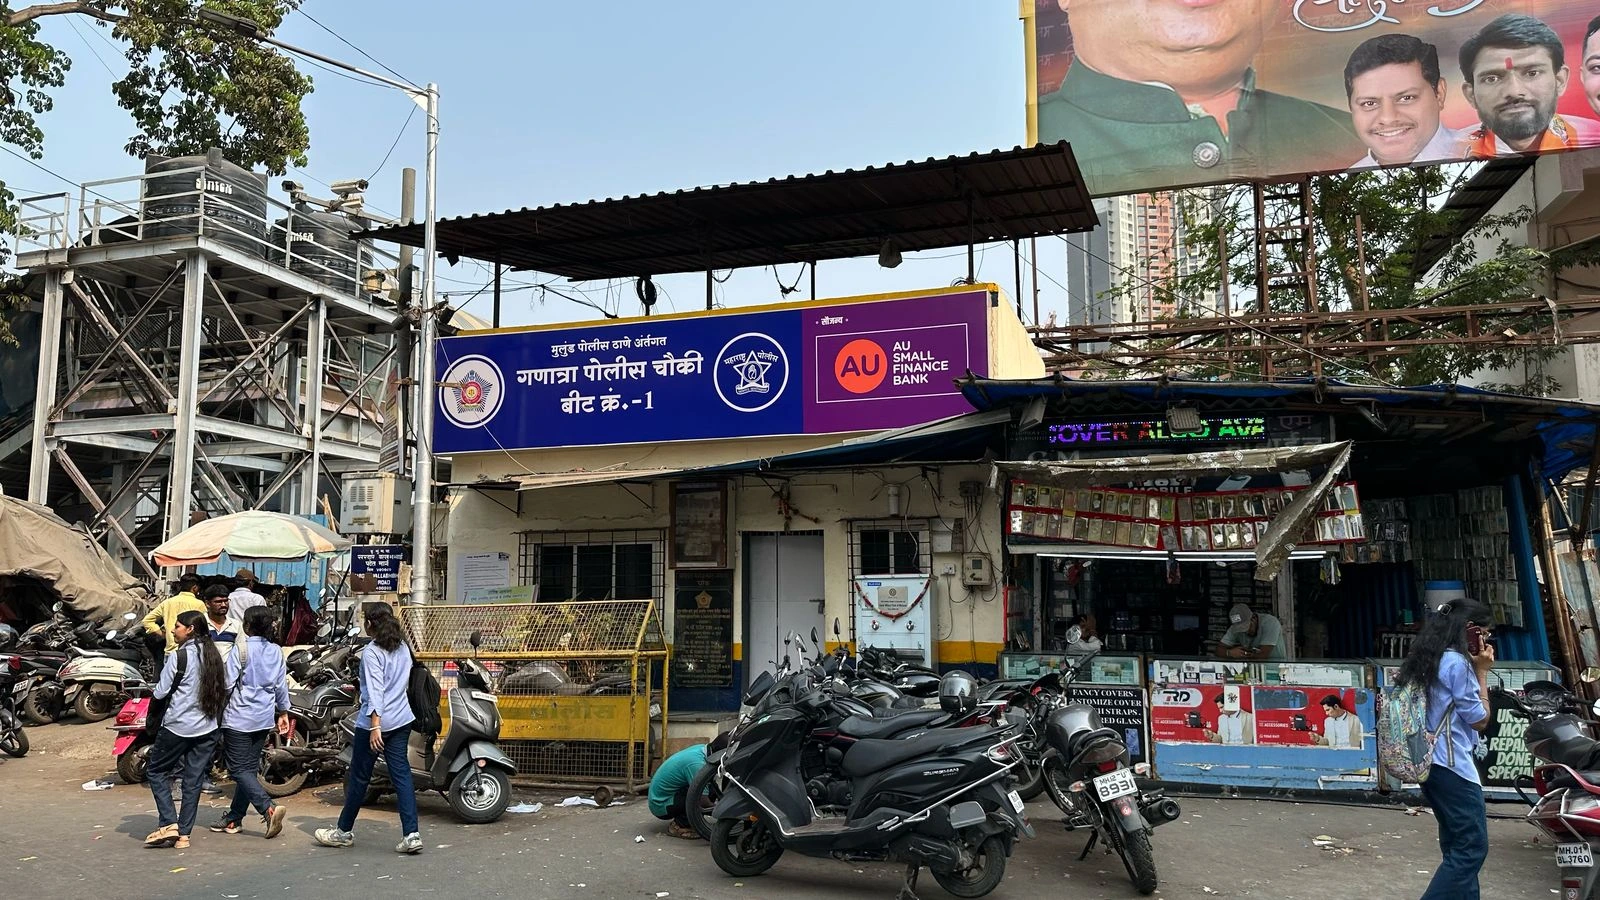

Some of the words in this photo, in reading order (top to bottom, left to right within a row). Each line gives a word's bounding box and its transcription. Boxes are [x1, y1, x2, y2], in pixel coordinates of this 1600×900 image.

[821, 316, 844, 326] सौजन्य
[551, 341, 576, 357] मुलुंड
[578, 339, 609, 353] पोलीस
[612, 336, 631, 349] ठाणे
[893, 341, 911, 352] AU
[893, 351, 935, 363] SMALL
[516, 366, 579, 386] गणात्रा
[583, 355, 648, 381] पोलीस
[651, 350, 704, 376] चौकी
[841, 354, 879, 378] AU
[893, 360, 949, 374] FINANCE
[893, 374, 929, 386] BANK
[560, 389, 596, 414] बीट
[1072, 689, 1100, 697] FANCY
[1113, 699, 1142, 707] COVER
[1116, 717, 1142, 725] GLASS
[1496, 752, 1532, 766] DONE
[1100, 779, 1134, 797] 8931
